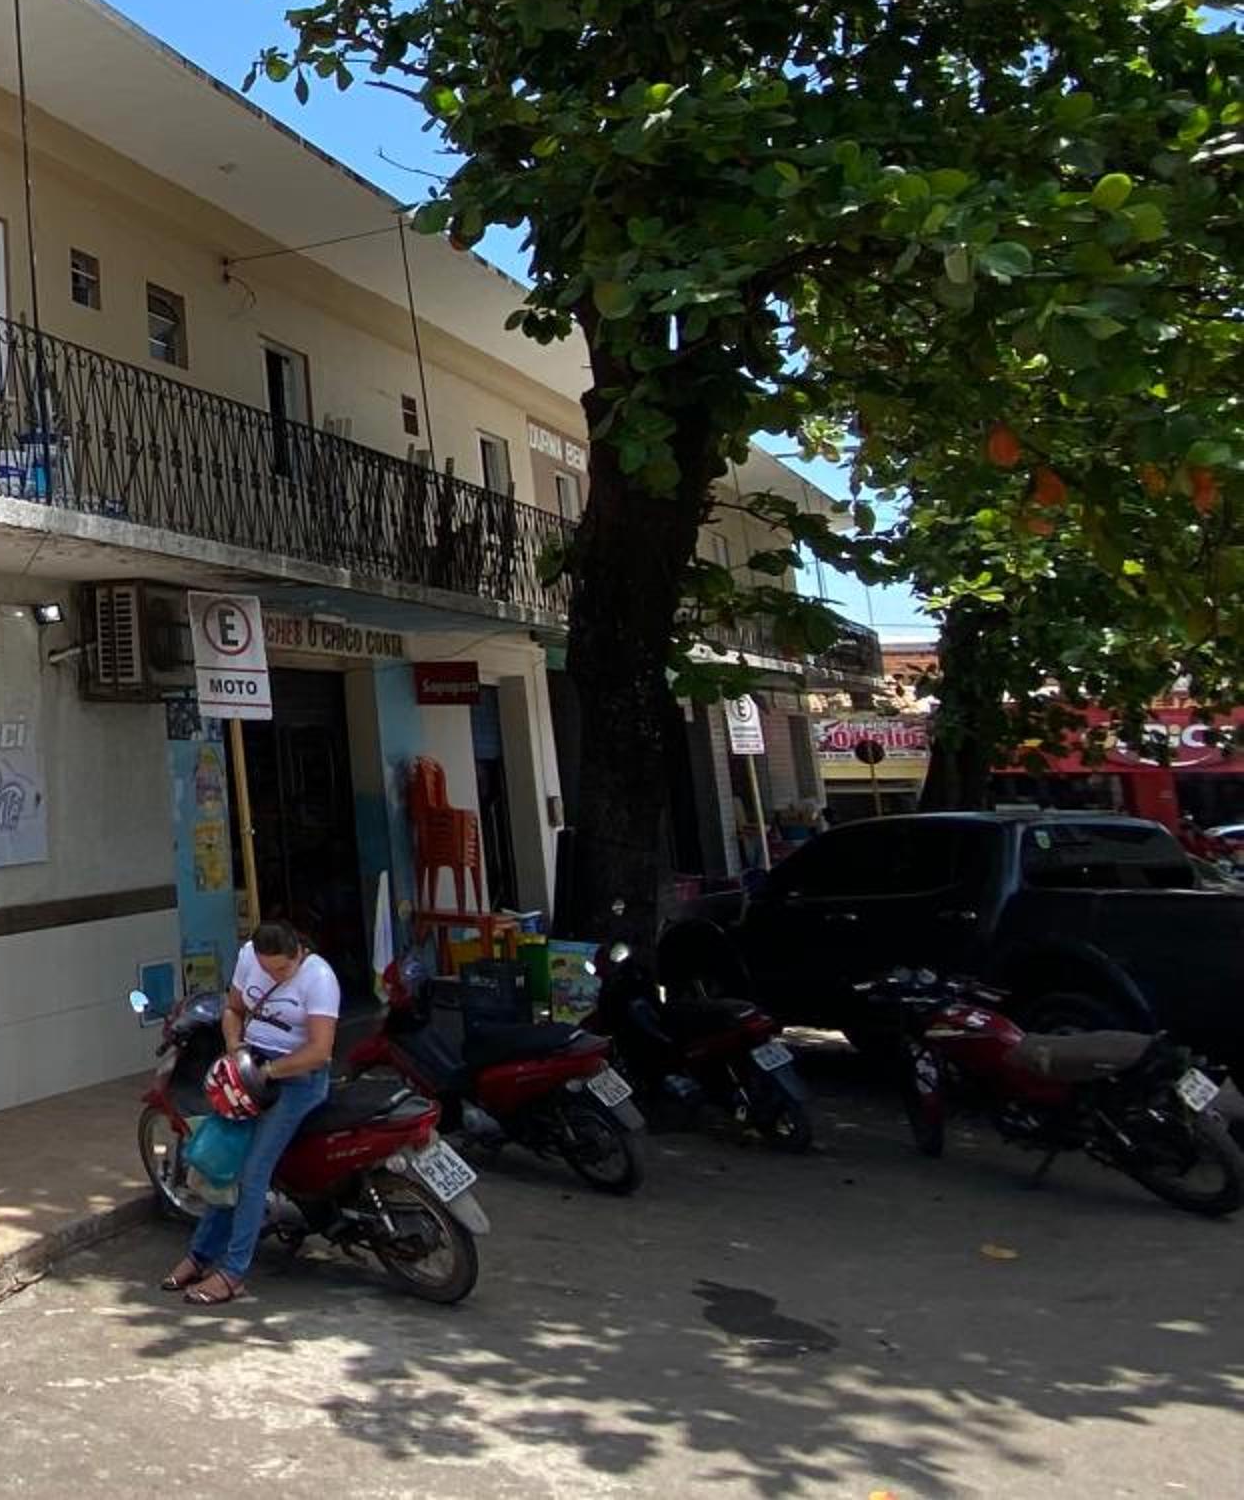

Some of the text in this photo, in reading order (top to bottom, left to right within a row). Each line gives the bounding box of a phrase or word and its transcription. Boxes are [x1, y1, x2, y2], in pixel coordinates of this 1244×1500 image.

[217, 608, 239, 647] E
[263, 616, 303, 645] CHES
[322, 624, 363, 653] CHICO
[209, 678, 258, 696] MOTO
